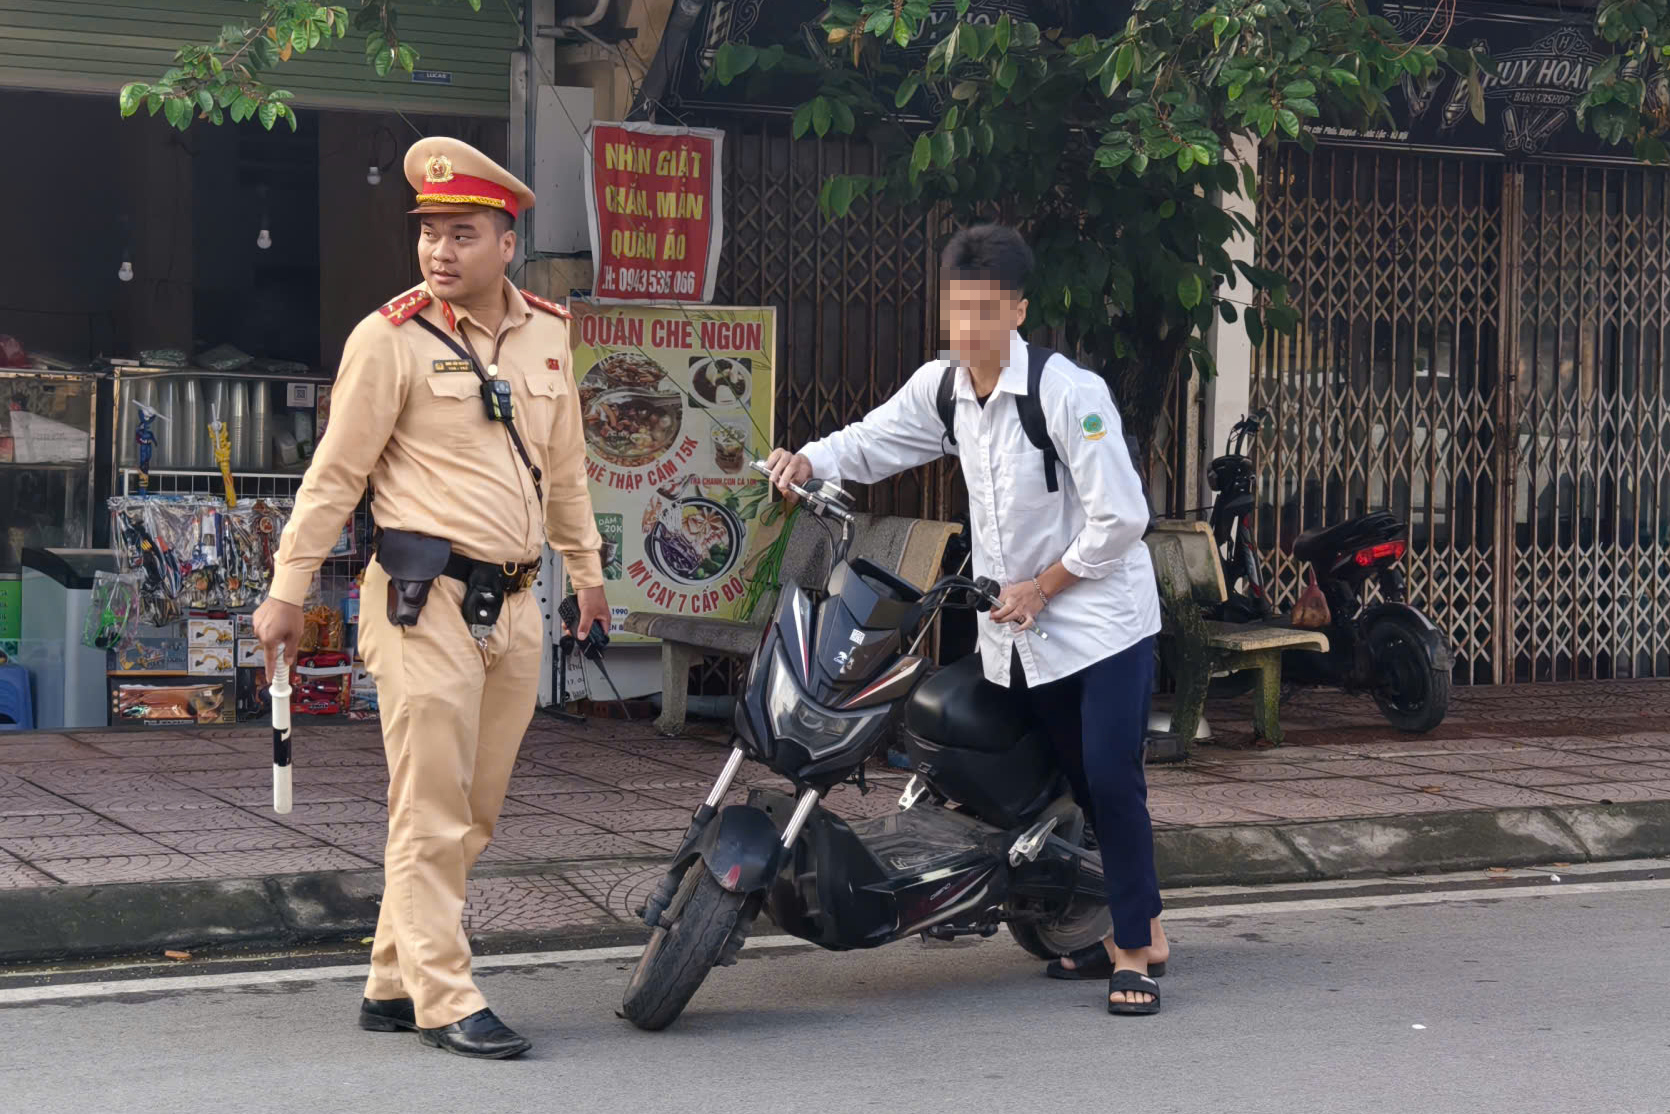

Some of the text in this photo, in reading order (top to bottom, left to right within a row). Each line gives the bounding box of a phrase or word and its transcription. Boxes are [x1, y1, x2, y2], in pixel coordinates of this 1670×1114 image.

[655, 144, 702, 183] GIẶT
[663, 228, 686, 260] ÁO
[619, 267, 648, 292] 0943
[582, 311, 644, 347] QUÁN
[700, 321, 761, 350] NGON
[608, 471, 643, 494] THẬP
[647, 459, 678, 486] CẨM
[674, 435, 699, 464] 15K
[604, 524, 623, 533] 20K
[646, 581, 676, 609] CAY
[678, 593, 688, 613] 7
[691, 585, 720, 613] CẤP
[721, 574, 745, 602] ĐỘ
